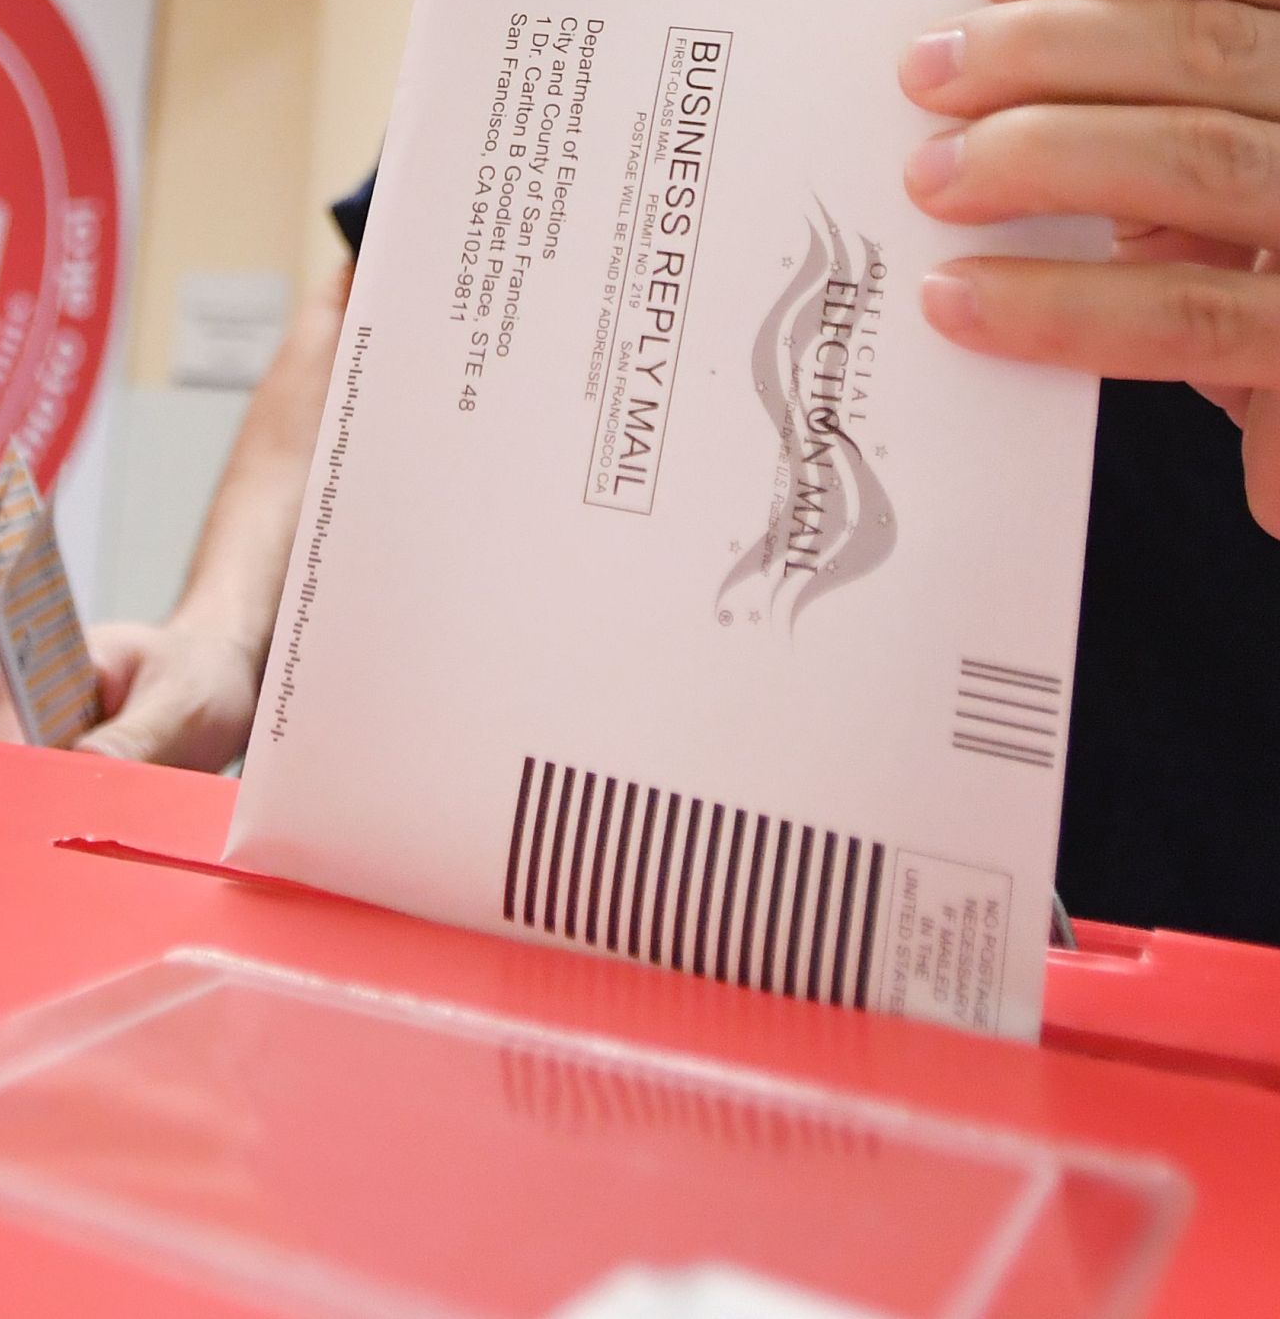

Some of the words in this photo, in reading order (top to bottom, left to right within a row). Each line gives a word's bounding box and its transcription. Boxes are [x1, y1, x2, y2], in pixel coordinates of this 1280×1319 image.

[504, 13, 528, 50] San
[535, 16, 552, 24] 1
[550, 16, 579, 53] City
[528, 33, 549, 59] Dr.
[545, 59, 569, 96] and
[562, 18, 605, 134] Department
[659, 37, 687, 127] FIRST-CLASS
[480, 57, 518, 158] Francisco,
[512, 66, 542, 137] Carlton
[508, 144, 526, 158] B
[526, 102, 561, 174] County
[560, 140, 581, 160] of
[623, 111, 648, 180] POSTAGE
[653, 131, 671, 165] MAIL
[658, 41, 721, 236] BUSINESS
[473, 165, 496, 196] CA
[525, 180, 546, 201] of
[616, 184, 634, 218] WILL
[488, 165, 522, 252] Goodlett
[516, 206, 541, 247] San
[541, 166, 576, 260] Elections
[638, 194, 659, 248] PERMIT
[612, 222, 627, 241] BE
[448, 201, 489, 322] 94102-9811
[605, 246, 623, 280] PAID
[632, 253, 649, 278] NO.
[472, 258, 503, 323] Place,
[494, 254, 531, 358] Francisco
[601, 284, 616, 303] BY
[627, 283, 643, 308] 219
[632, 250, 685, 386] REPLY
[463, 330, 489, 377] STE
[583, 308, 612, 402] ADDRESSEE
[616, 340, 633, 371] SAN
[847, 261, 888, 425] OFFICIAL
[798, 278, 859, 473] ELECTION
[456, 384, 479, 412] 48
[598, 376, 626, 468] FRANCISCO
[611, 398, 659, 499] MAIL
[593, 471, 609, 494] CA
[782, 479, 830, 583] MAIL
[897, 867, 920, 941] UNITED
[982, 899, 1000, 929] NO
[913, 941, 933, 981] THE
